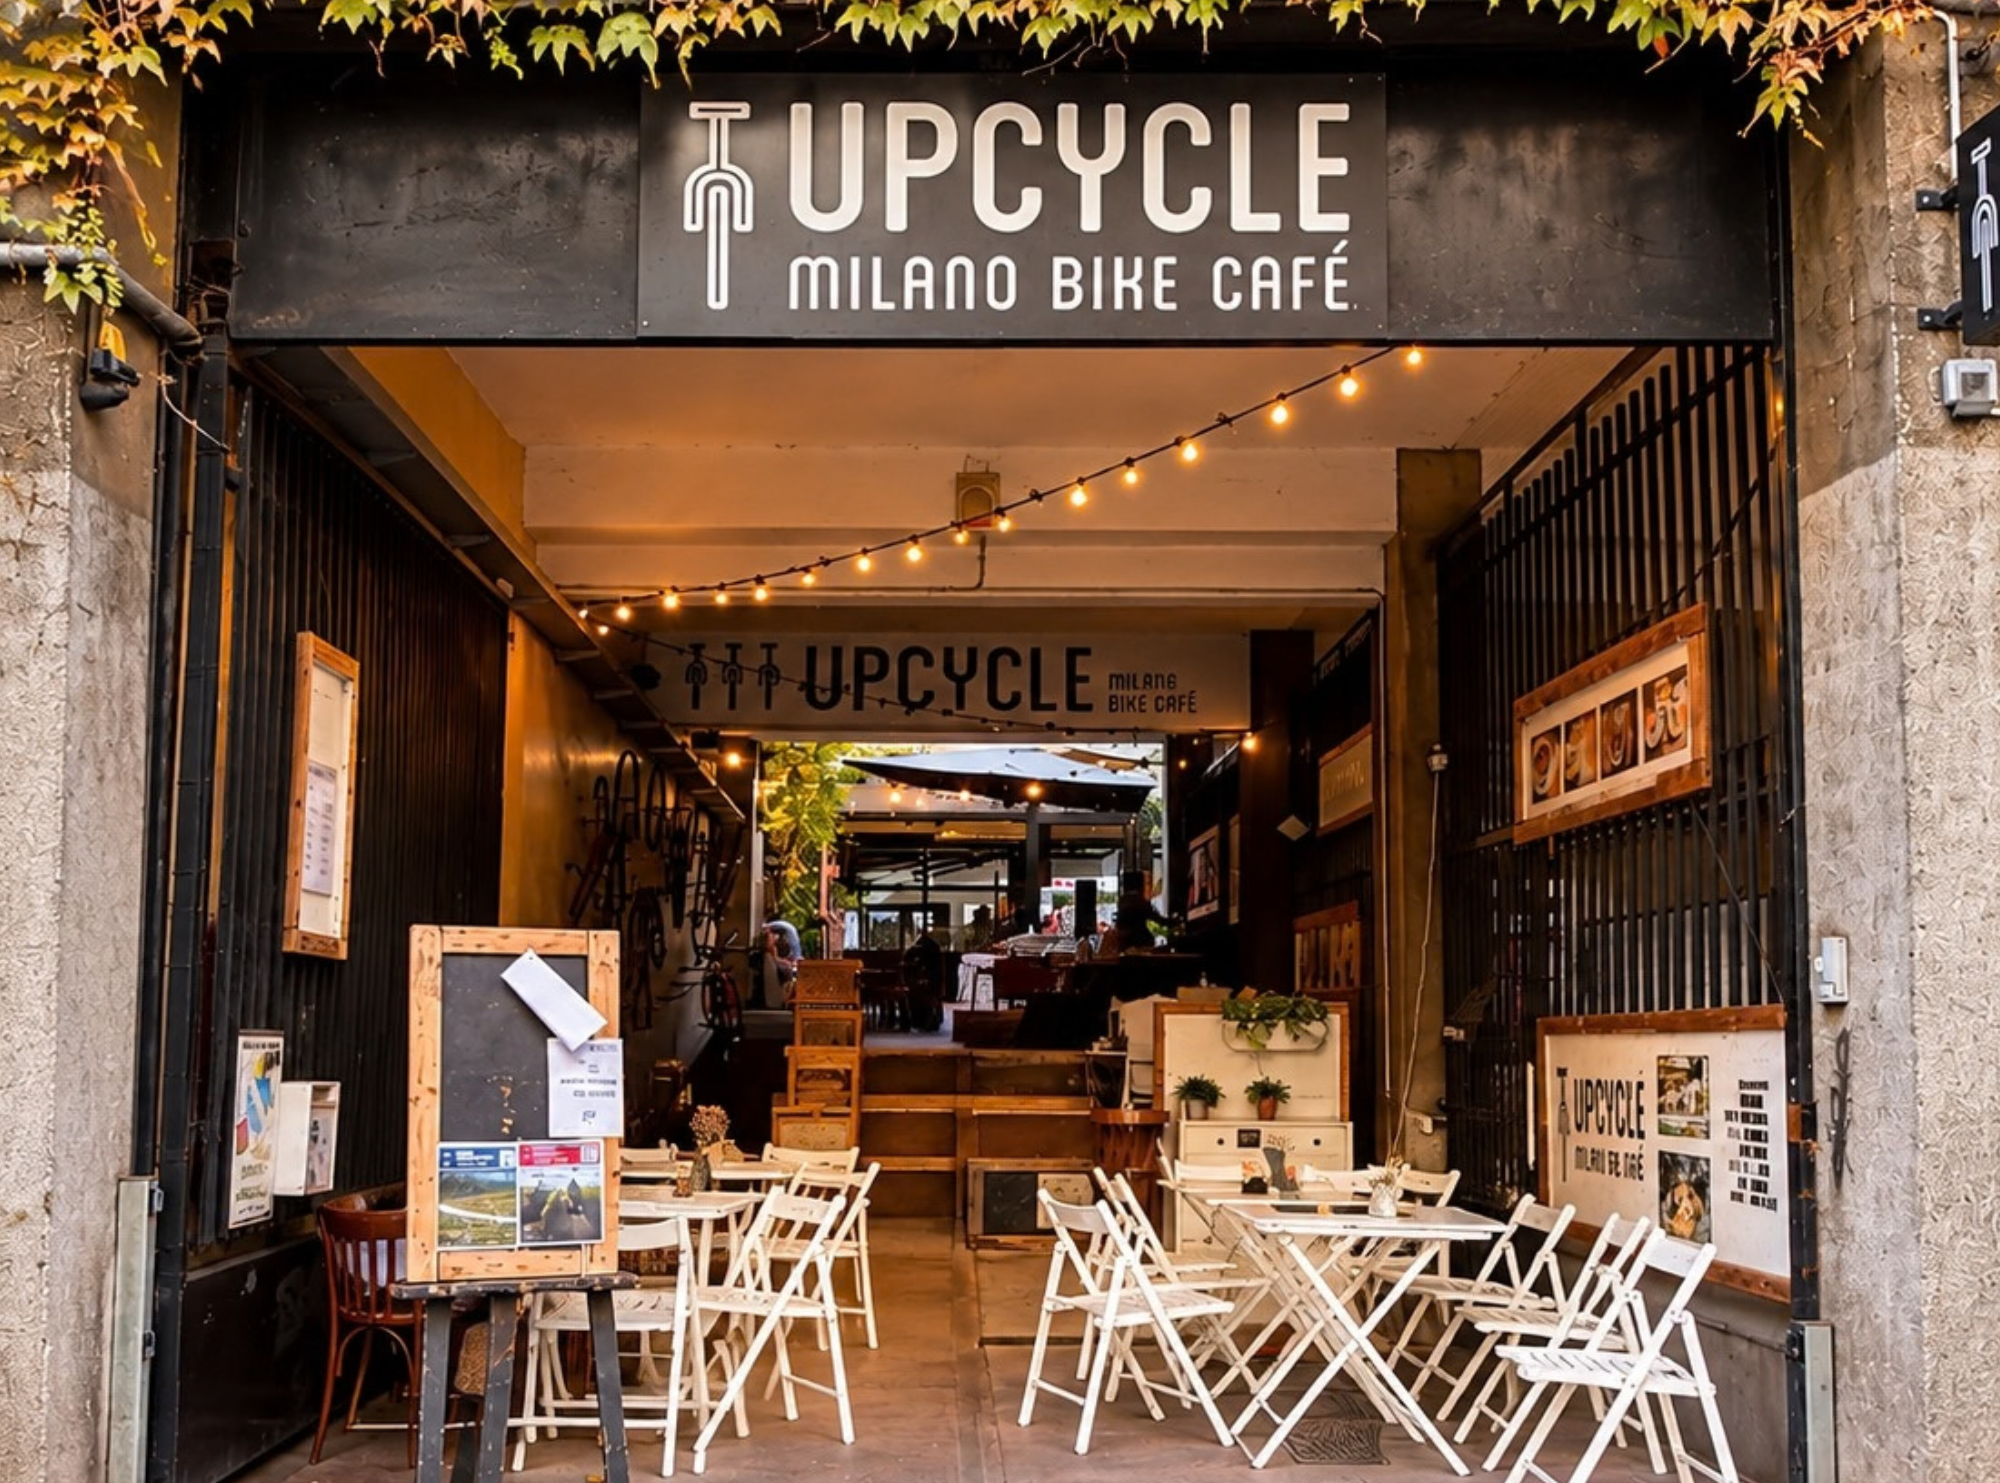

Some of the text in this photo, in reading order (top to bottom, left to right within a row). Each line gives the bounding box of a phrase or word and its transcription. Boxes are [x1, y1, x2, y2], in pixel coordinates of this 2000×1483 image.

[789, 102, 1351, 233] UPCYCLE
[788, 239, 1350, 311] MILANO BIKE CAFÉ
[805, 646, 1093, 712] UPCYCLE
[1108, 689, 1197, 714] BIKE CAFÉ
